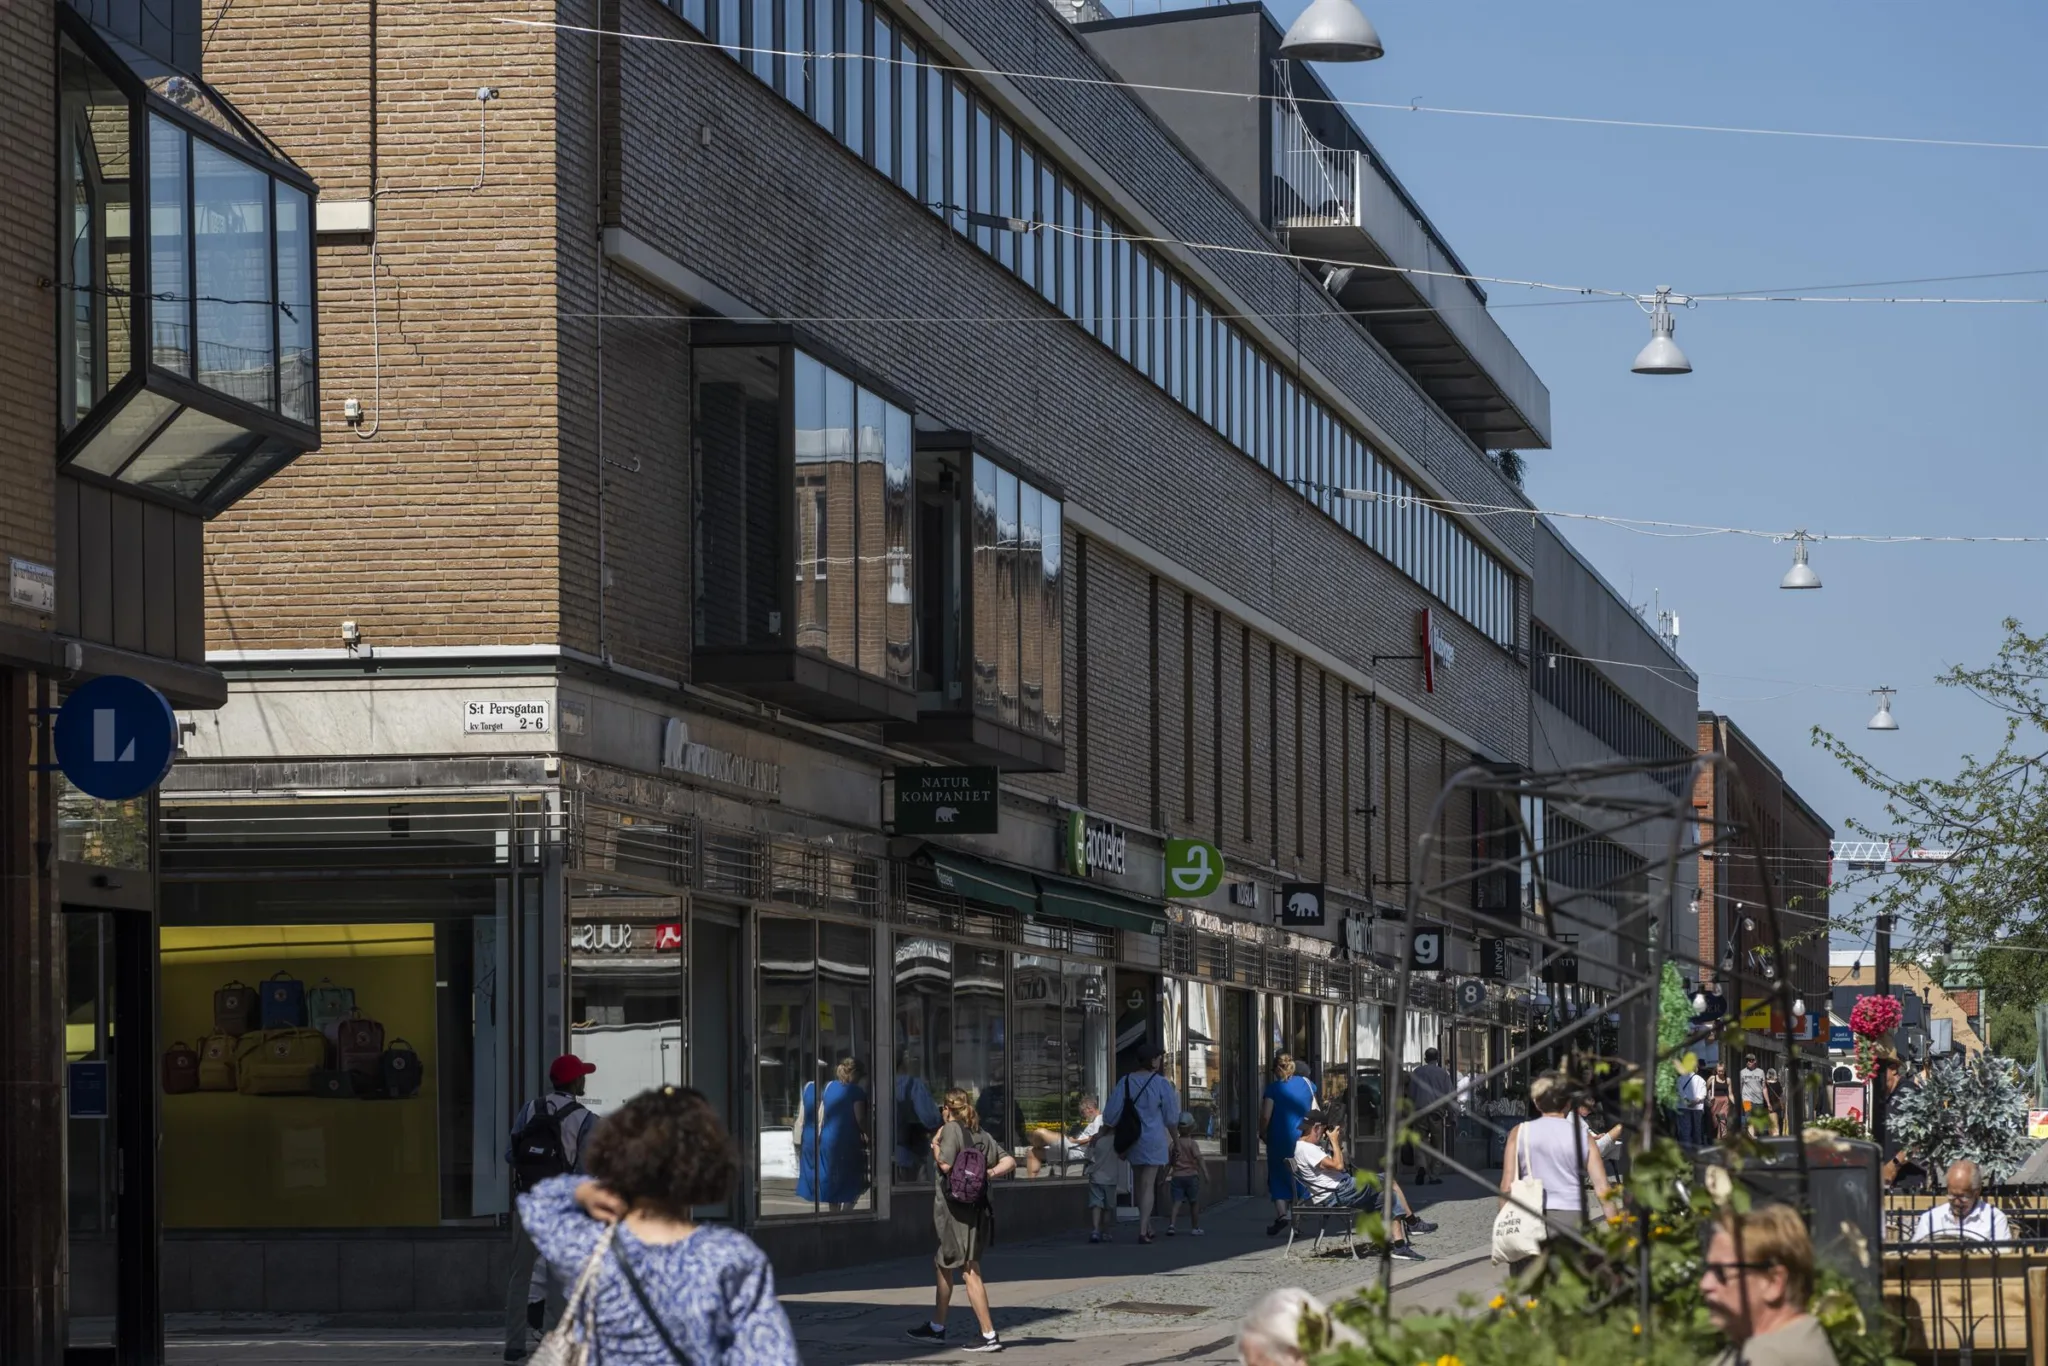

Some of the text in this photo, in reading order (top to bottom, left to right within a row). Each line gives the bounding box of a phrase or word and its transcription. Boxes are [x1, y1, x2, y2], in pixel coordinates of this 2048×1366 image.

[469, 702, 545, 718] S:t Persgatan
[480, 722, 504, 732] Torget
[921, 777, 970, 788] NATUR
[901, 790, 991, 802] KOMPANIET
[1085, 820, 1126, 878] apoteket
[1414, 933, 1439, 964] g
[1494, 939, 1504, 976] GRANIT
[1464, 985, 1478, 1003] 8
